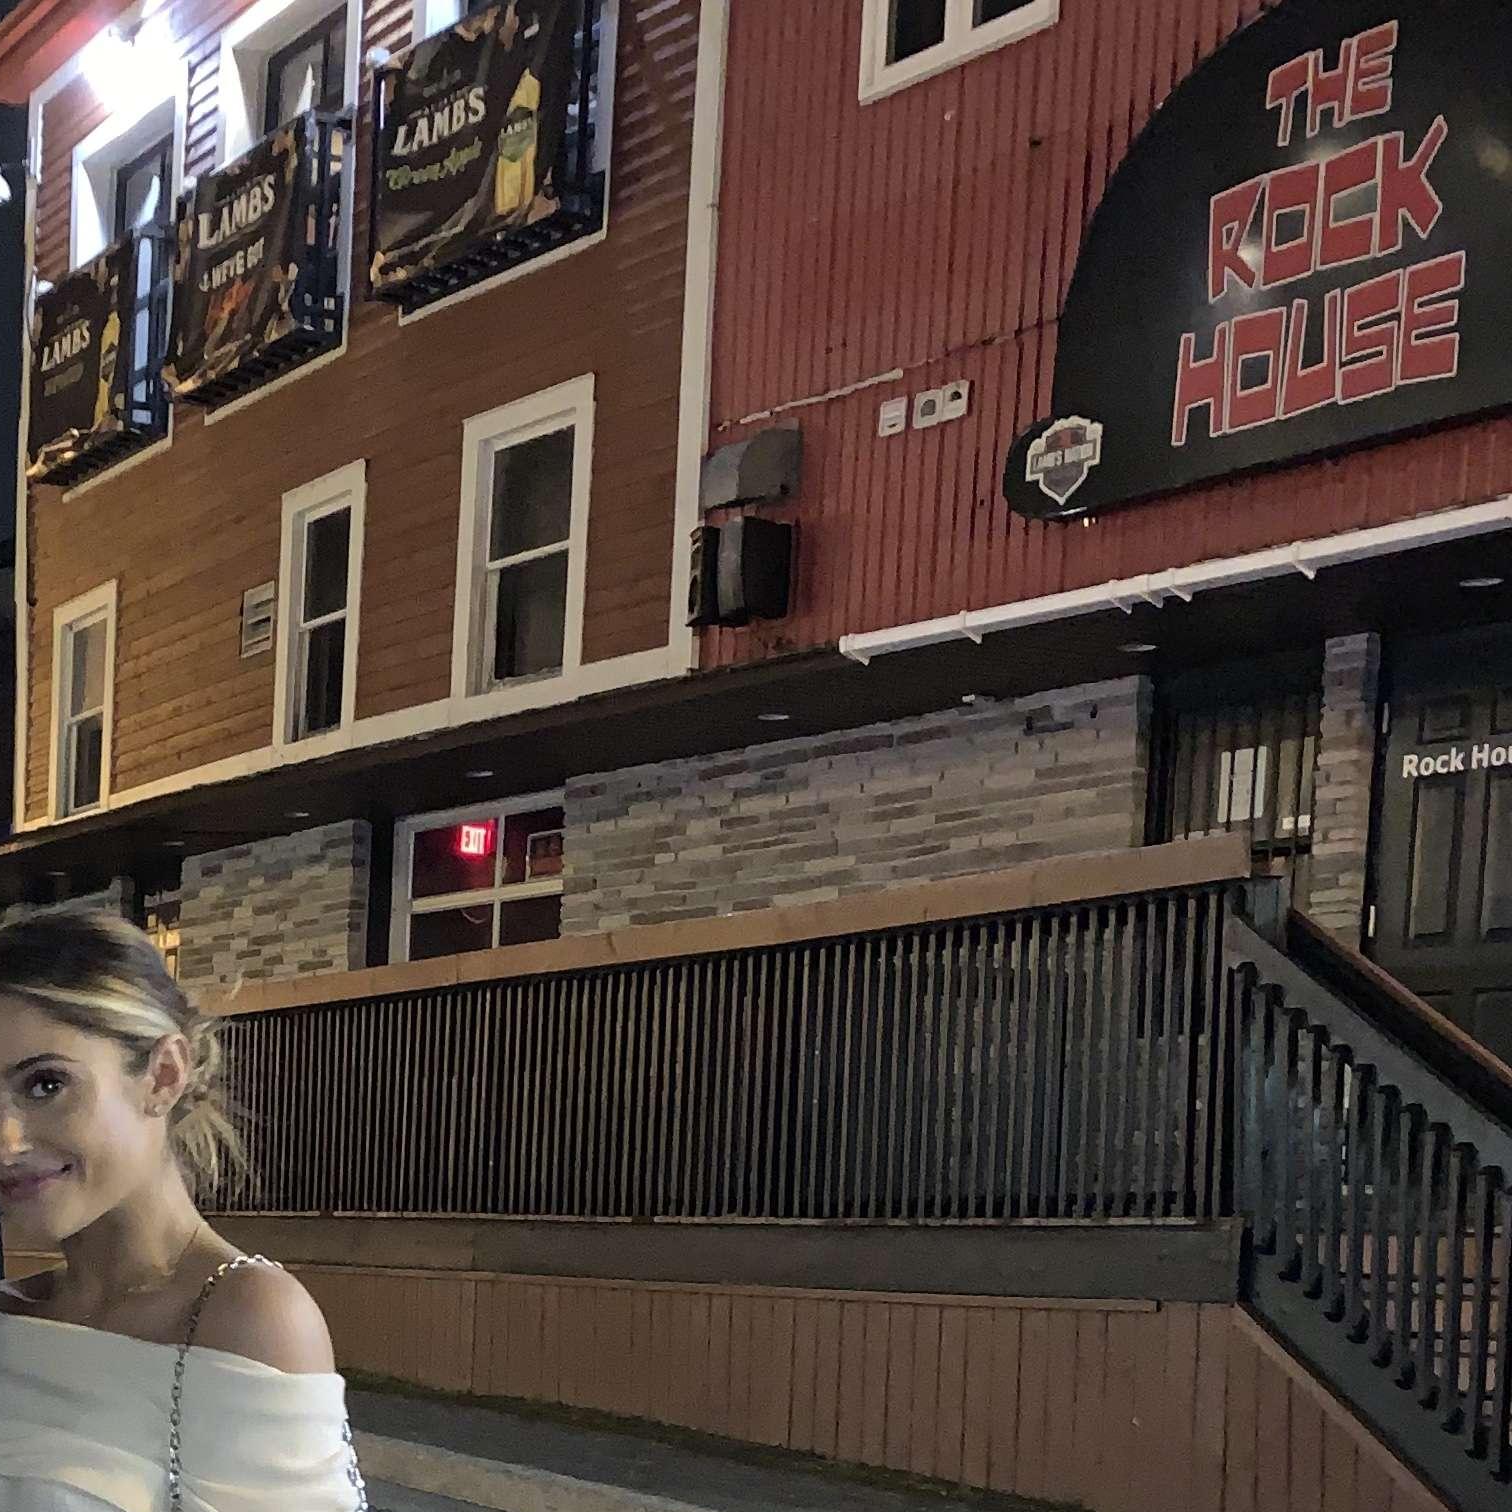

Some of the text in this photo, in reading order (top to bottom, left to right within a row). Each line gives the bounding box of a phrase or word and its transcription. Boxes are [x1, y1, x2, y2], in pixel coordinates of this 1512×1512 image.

[1265, 20, 1398, 146] THE
[1209, 115, 1448, 304] ROCK
[1171, 251, 1466, 447] HOUSE
[1402, 746, 1466, 779] Rock
[461, 825, 486, 855] EXIT
